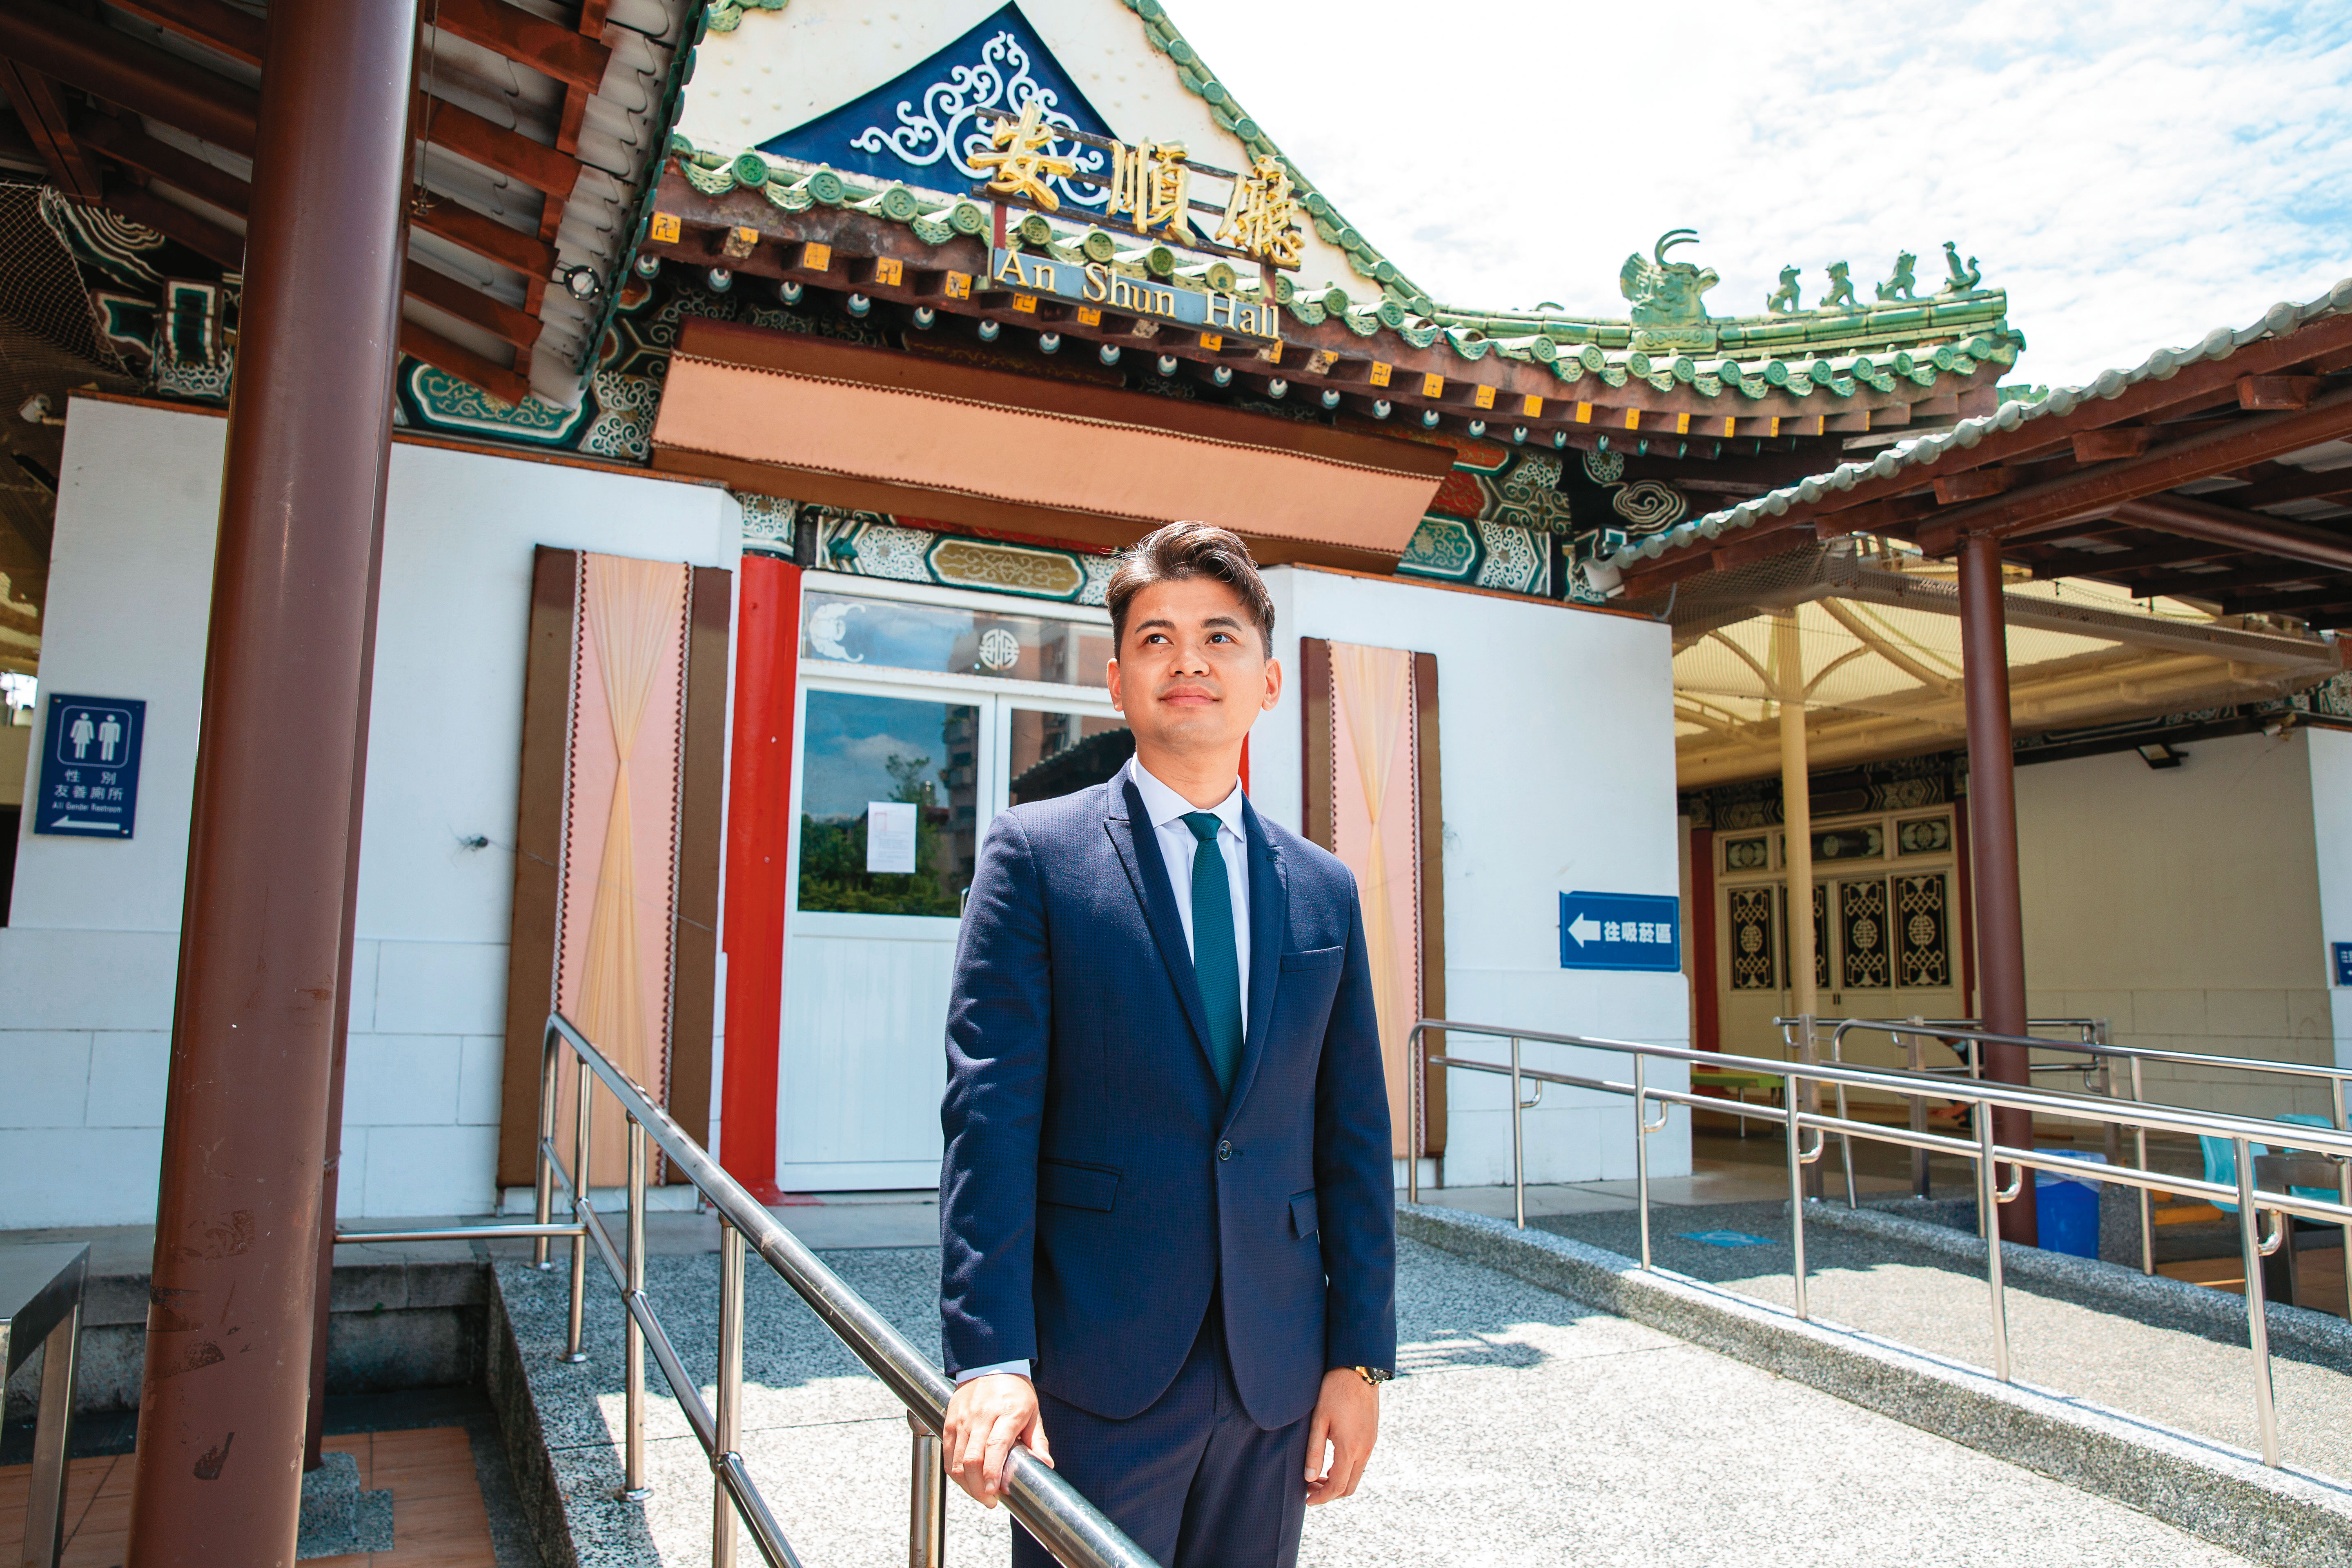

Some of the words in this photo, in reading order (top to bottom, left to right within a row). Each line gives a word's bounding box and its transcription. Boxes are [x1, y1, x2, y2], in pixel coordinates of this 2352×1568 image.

[994, 246, 1057, 293] An
[1083, 262, 1176, 318] Shun
[1203, 288, 1280, 340] Hall
[54, 784, 123, 801] 友善廁所
